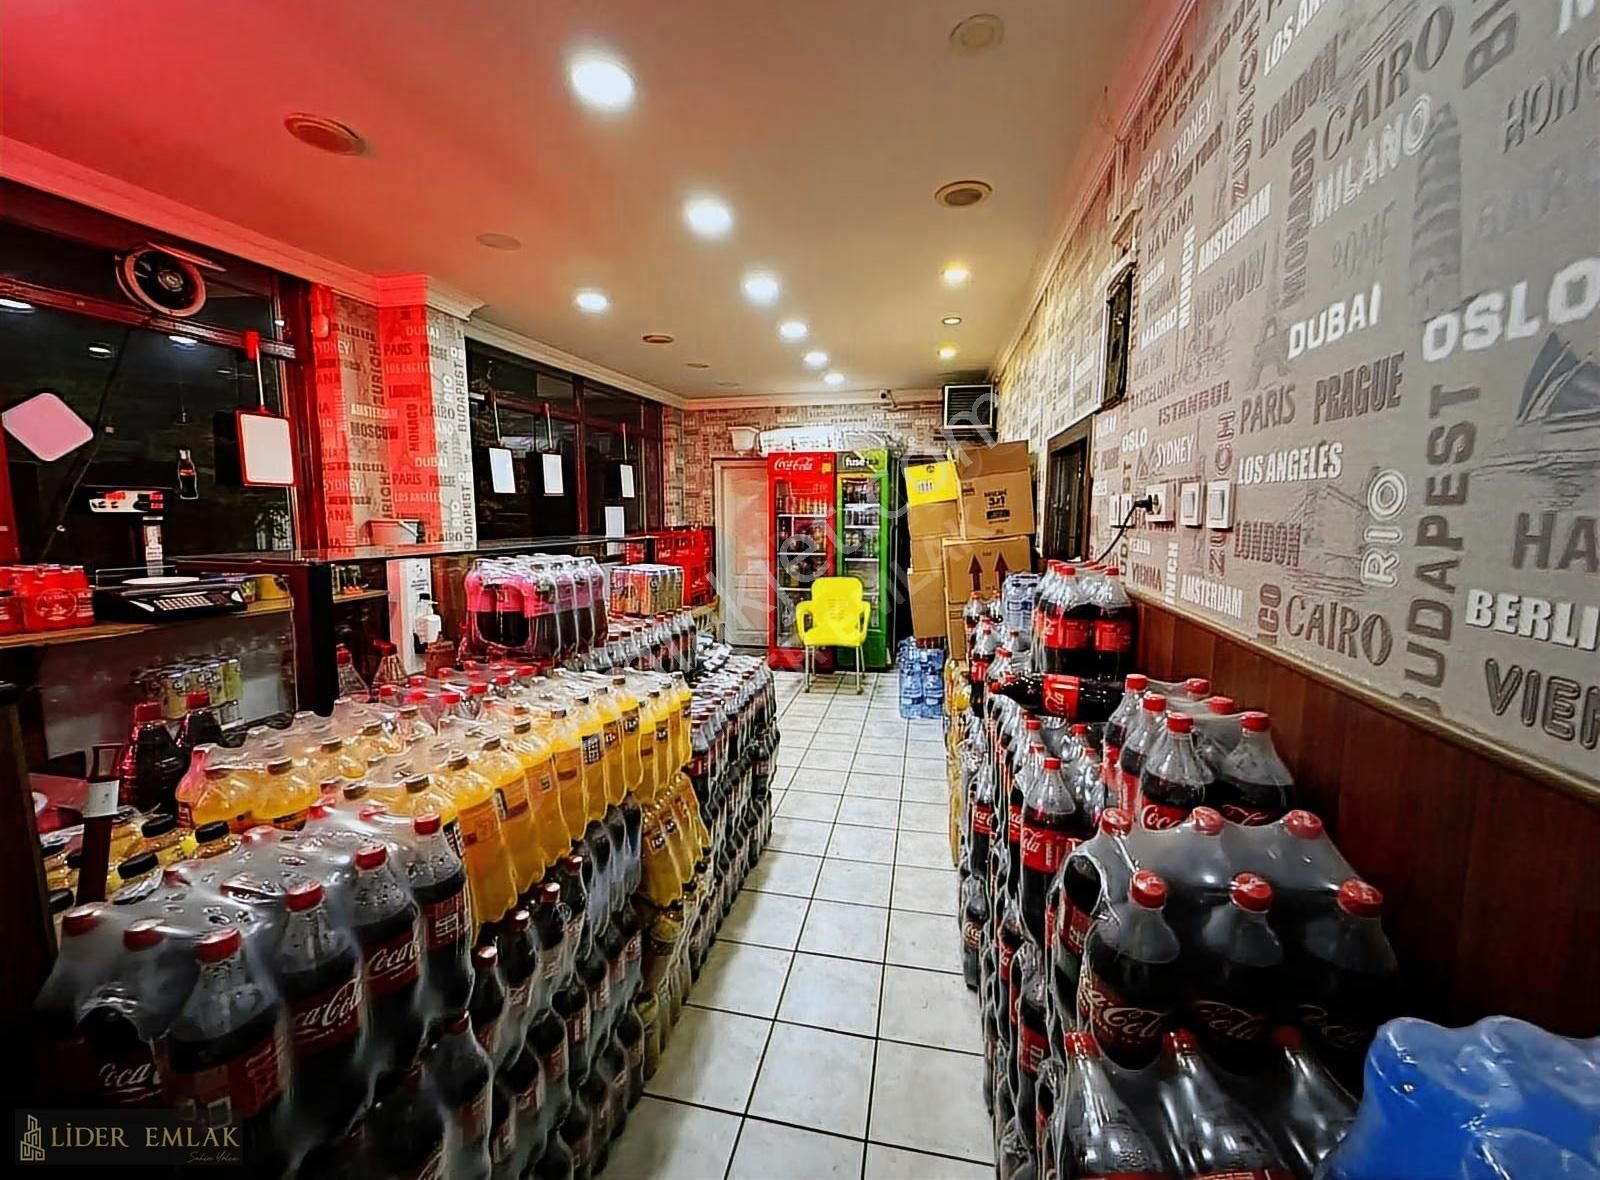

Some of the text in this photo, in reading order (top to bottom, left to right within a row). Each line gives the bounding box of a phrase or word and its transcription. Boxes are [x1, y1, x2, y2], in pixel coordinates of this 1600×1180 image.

[1263, 14, 1293, 77] LOS
[1322, 4, 1455, 161] CAIRO
[1311, 92, 1431, 228] MILANO
[1199, 183, 1271, 273] AMSTERDAM
[1287, 282, 1382, 361] DUBAI
[1422, 257, 1600, 362] OSLO
[1157, 380, 1232, 426] ISTANBUL
[1239, 384, 1297, 434] PARIS
[1313, 352, 1405, 424] PRAGUE
[350, 420, 399, 441] MOSCOW
[1121, 427, 1148, 453] OSLO
[1155, 433, 1195, 469] SYDNEY
[1237, 442, 1344, 485] LOS ANGELES
[1234, 520, 1301, 568] LONDON
[1360, 468, 1408, 588] RIO
[1180, 574, 1243, 619] AMSTERDAM
[1285, 594, 1393, 666] CAIRO
